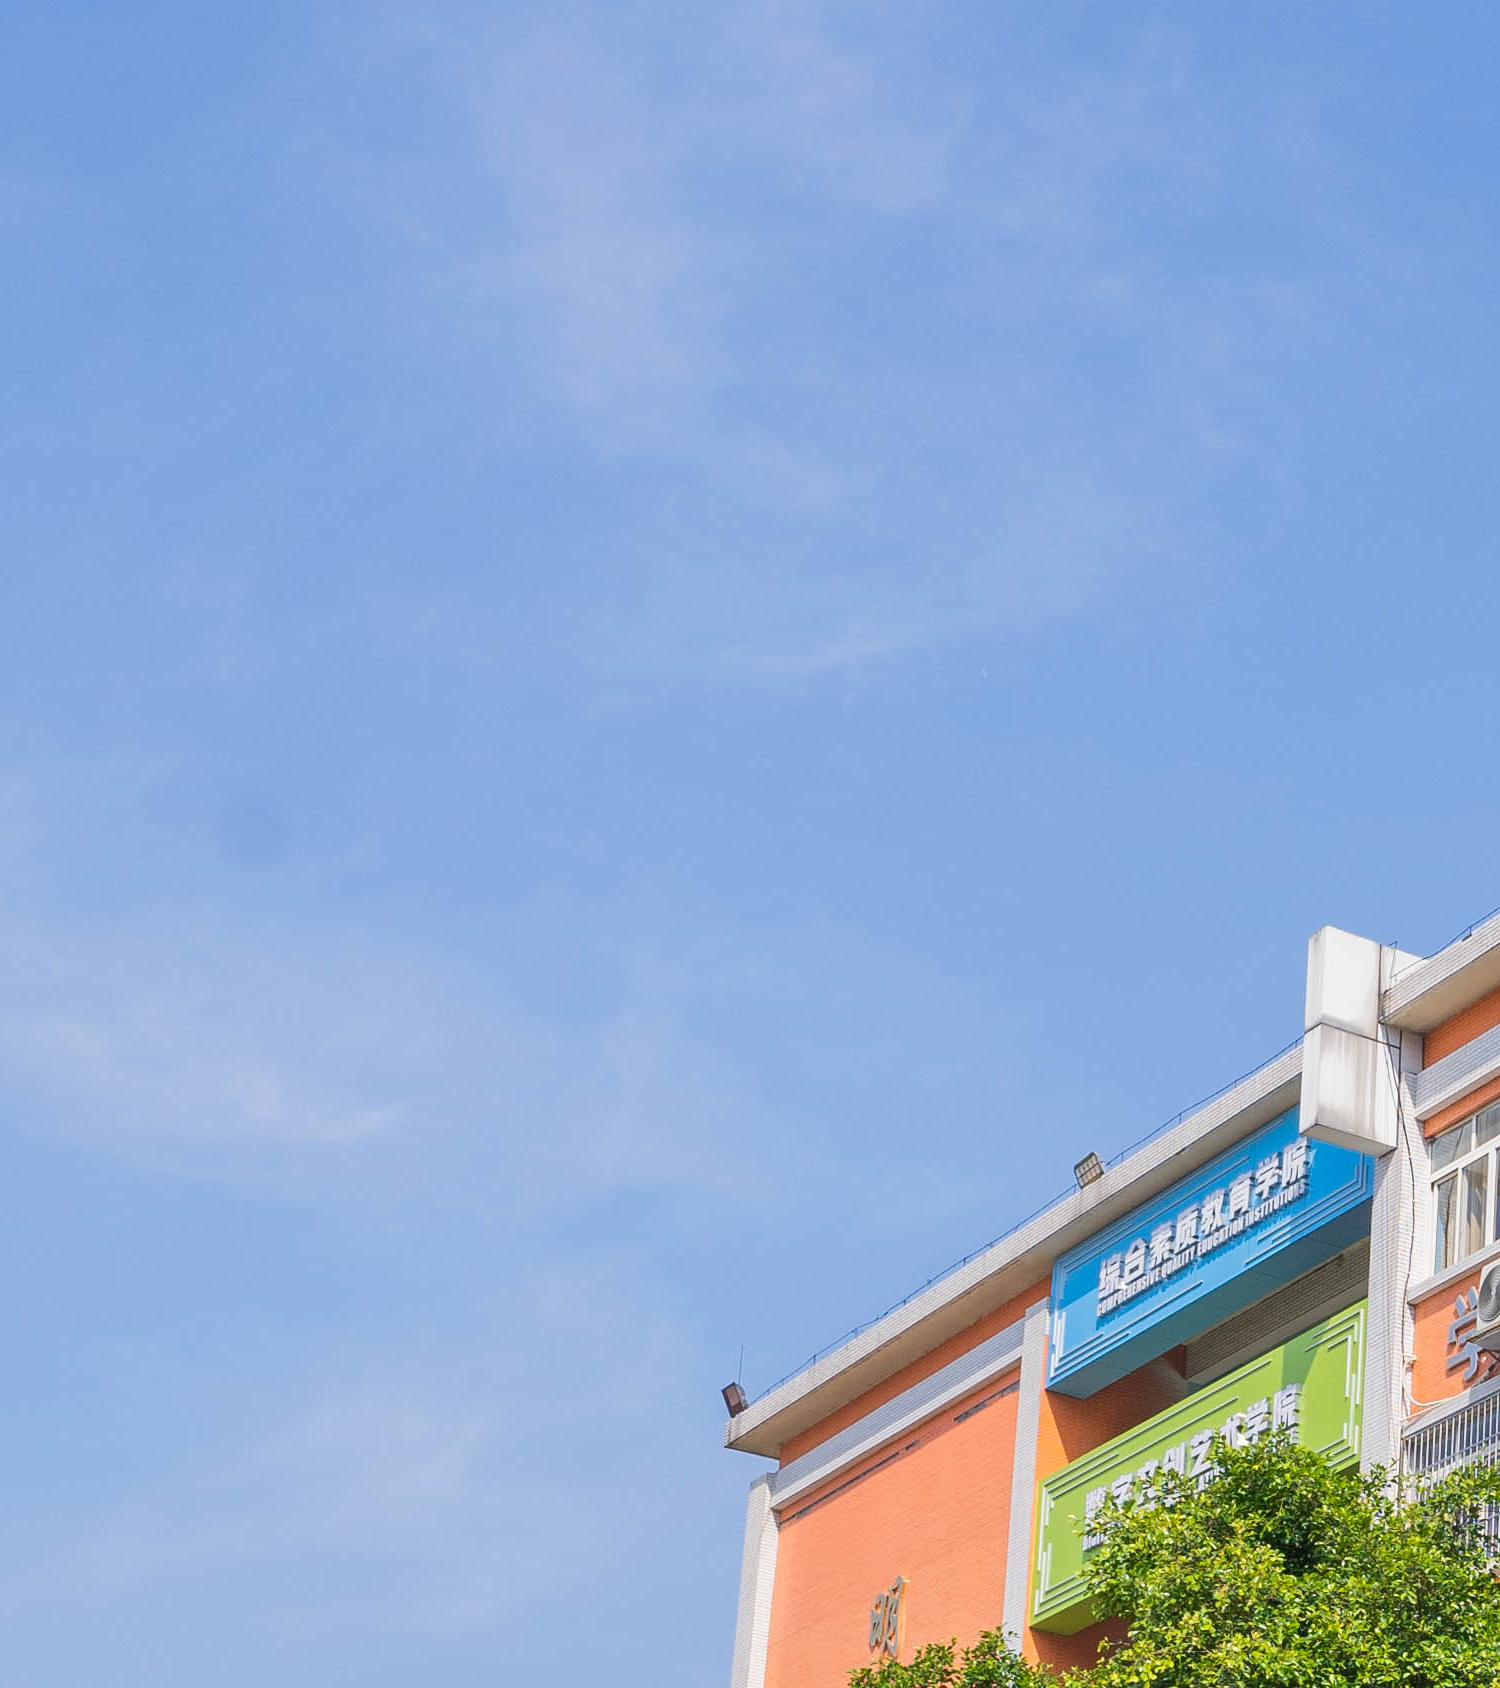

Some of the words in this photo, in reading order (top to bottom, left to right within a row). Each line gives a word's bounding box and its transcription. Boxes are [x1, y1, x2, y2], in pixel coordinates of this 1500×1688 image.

[1098, 1136, 1309, 1299] 综合素质教育学院
[1161, 1248, 1196, 1279] QUALITY
